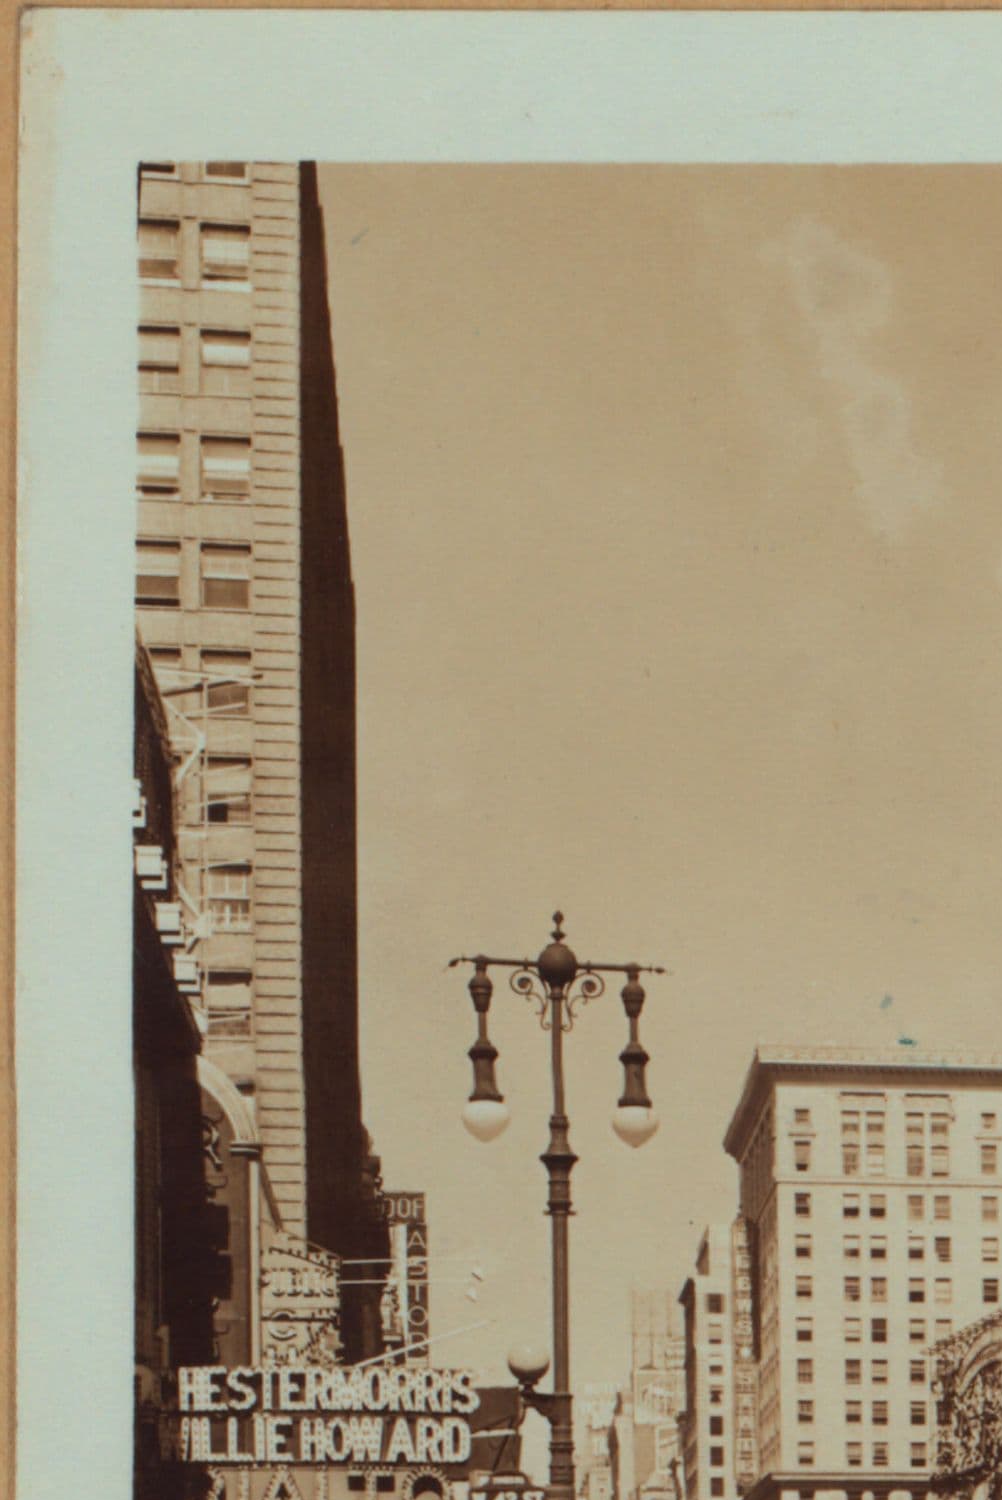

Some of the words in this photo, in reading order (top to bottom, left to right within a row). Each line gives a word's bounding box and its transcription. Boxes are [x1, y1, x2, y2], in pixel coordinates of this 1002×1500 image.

[407, 1230, 429, 1354] ASTOR
[163, 1366, 330, 1411] HESTER
[330, 1366, 480, 1412] MORRIS
[300, 1415, 471, 1463] HOWARD
